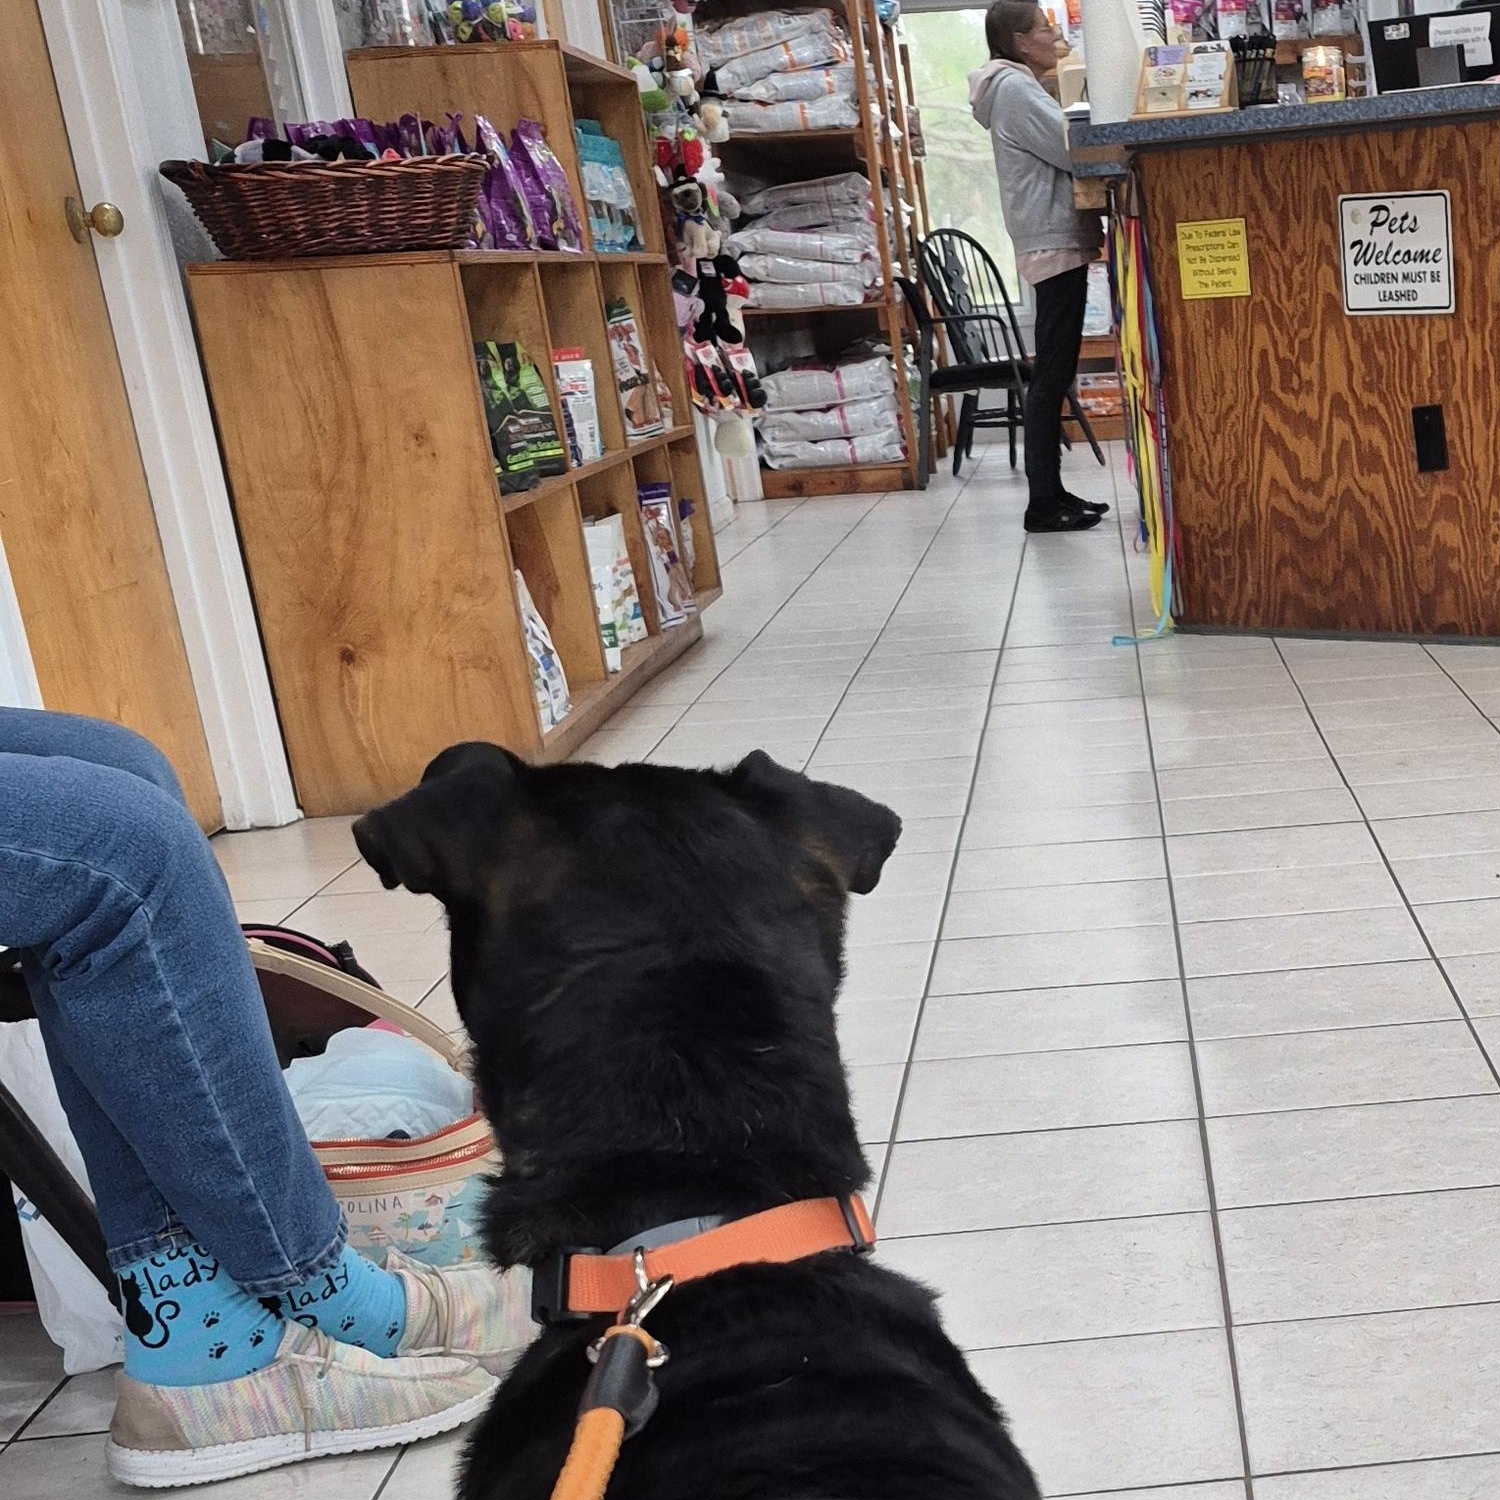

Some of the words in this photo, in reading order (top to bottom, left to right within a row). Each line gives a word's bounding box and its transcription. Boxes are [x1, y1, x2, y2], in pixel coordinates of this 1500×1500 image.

[1368, 204, 1420, 236] Pets
[1194, 230, 1203, 239] To
[1204, 229, 1227, 238] Federal
[1228, 227, 1241, 236] Law
[1185, 242, 1225, 252] Prescriptions
[1226, 240, 1240, 249] Can
[1208, 254, 1241, 263] Dispensed
[1349, 238, 1443, 267] Welcome
[1192, 268, 1215, 277] Without
[1217, 267, 1238, 276] Seeing
[1353, 272, 1399, 285] CHILDREN
[1402, 270, 1427, 284] MUST
[1430, 270, 1441, 283] BE
[1197, 280, 1209, 289] The
[1378, 289, 1418, 302] LEASHED
